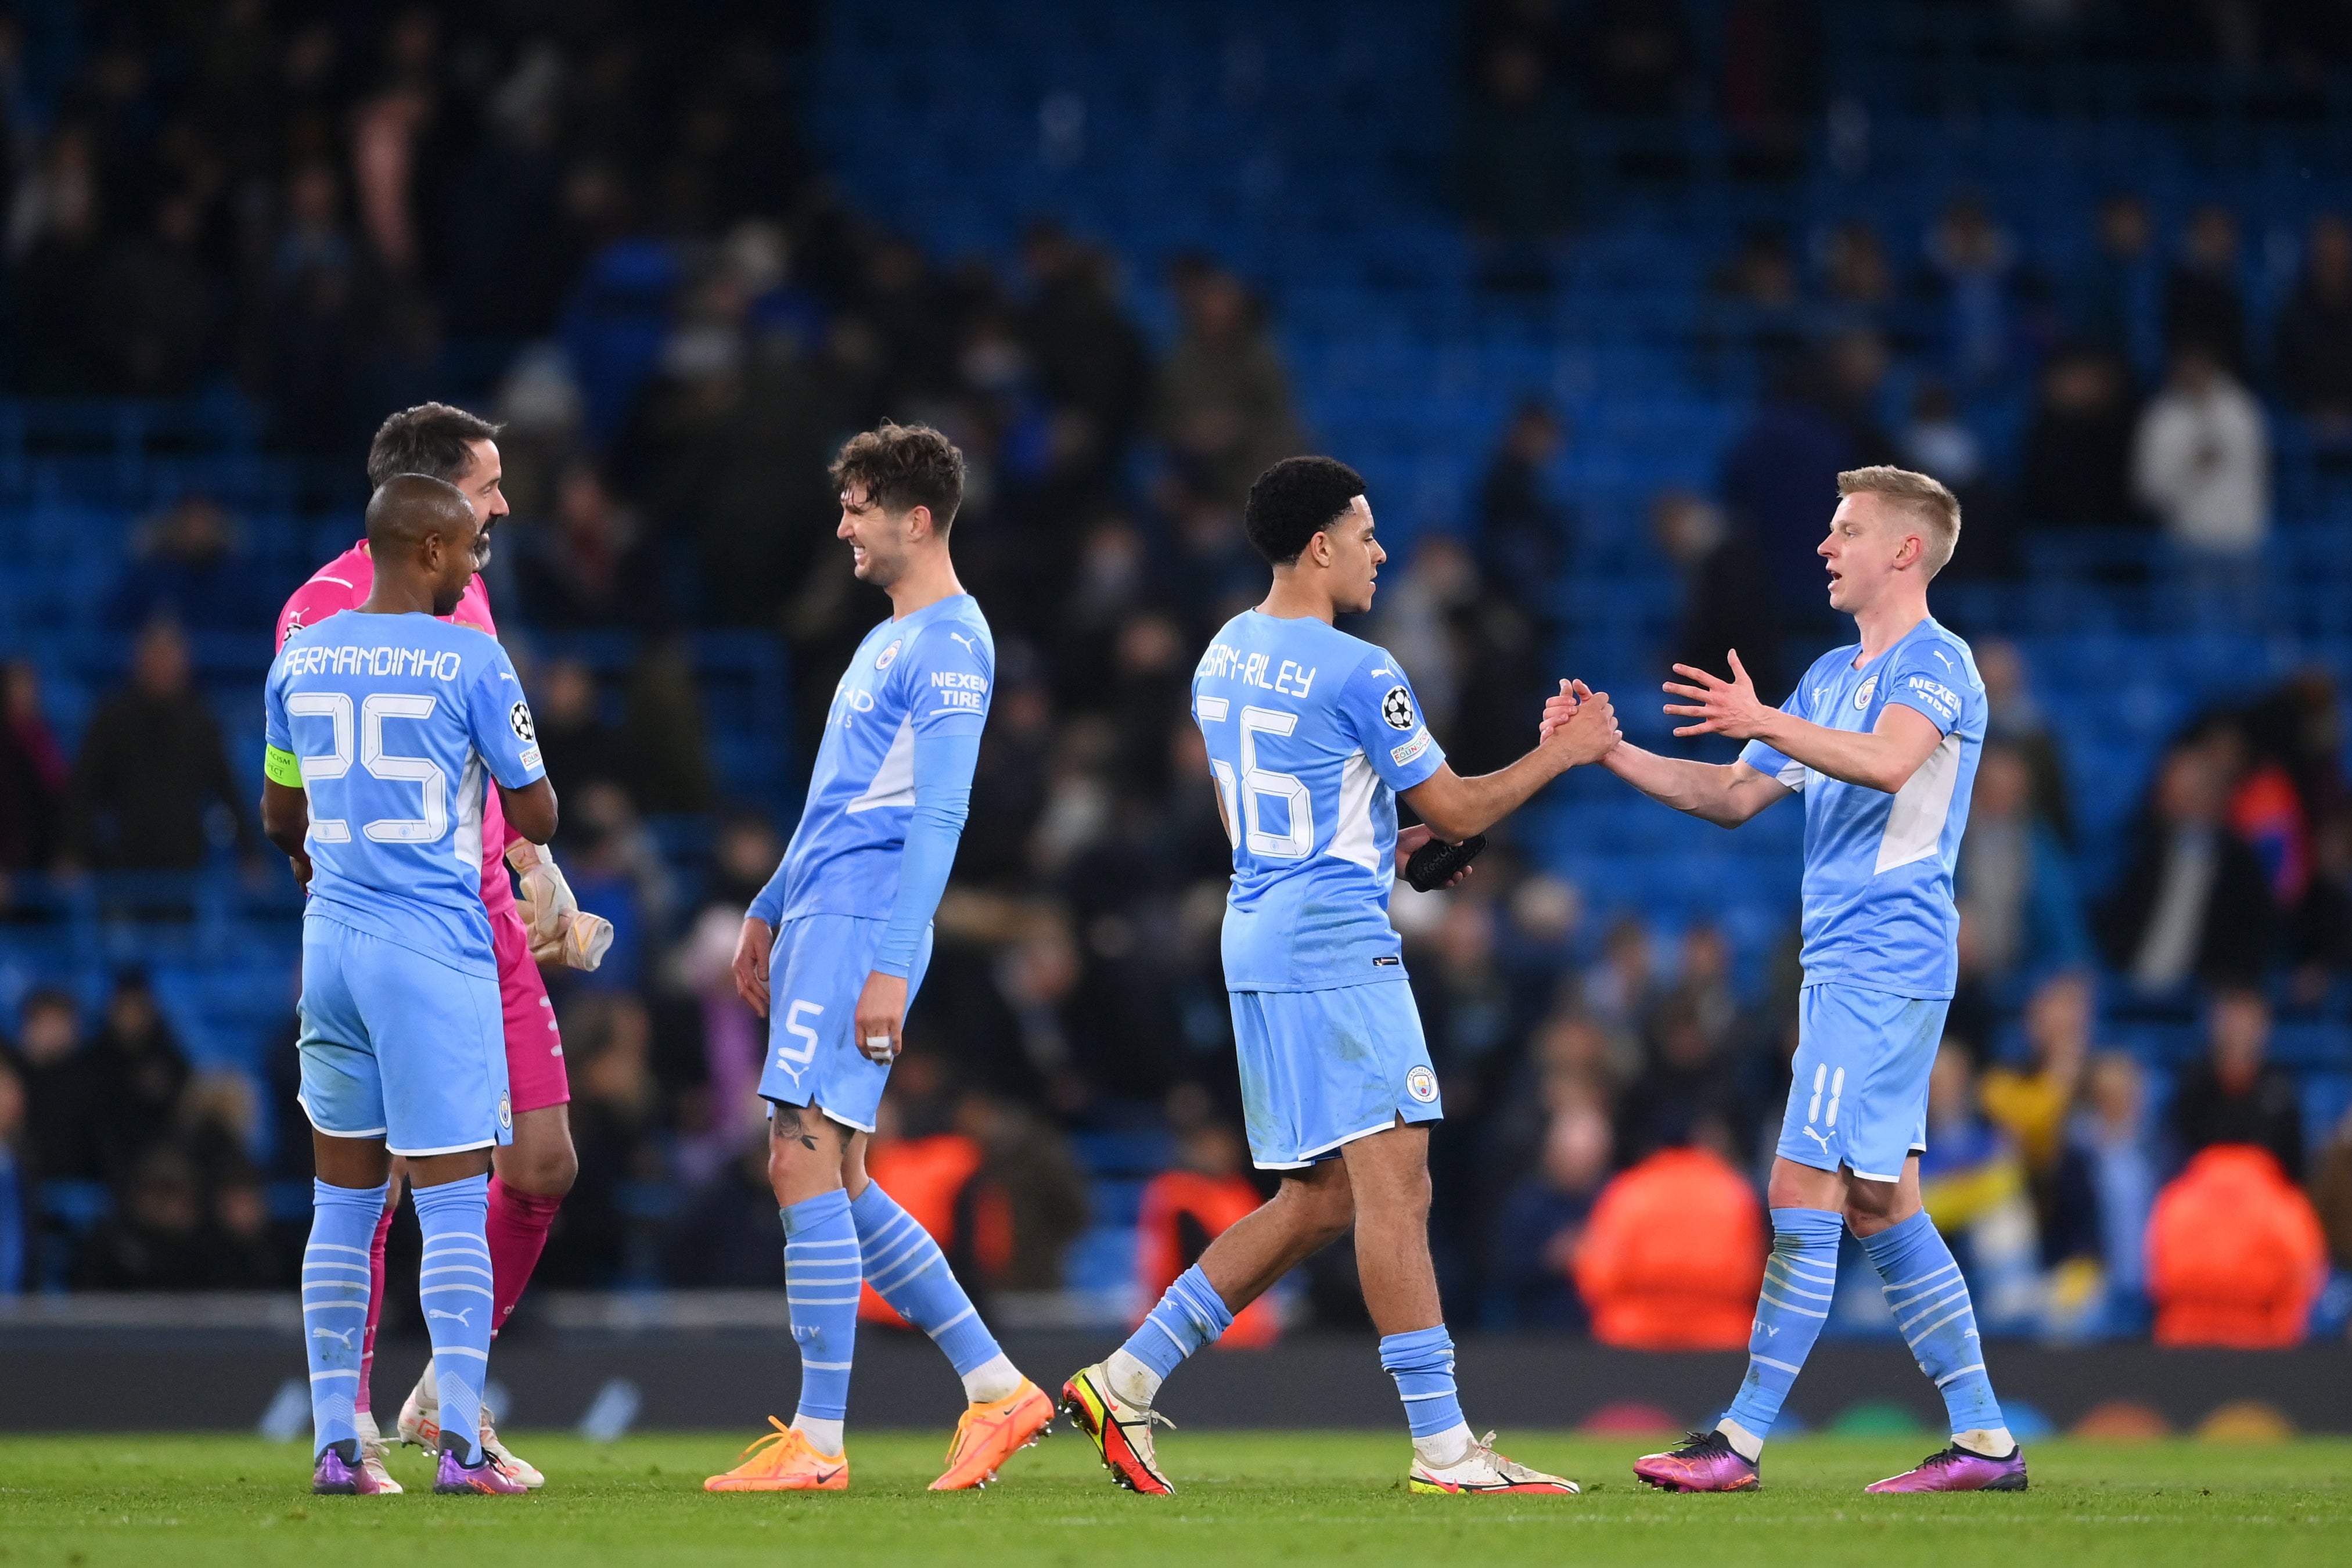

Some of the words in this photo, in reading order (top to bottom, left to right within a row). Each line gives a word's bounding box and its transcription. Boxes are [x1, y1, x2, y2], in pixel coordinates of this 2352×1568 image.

[282, 646, 461, 682] FERNANDINHO
[931, 672, 988, 693] NEXEN
[940, 690, 981, 708] TIRE
[1908, 677, 1962, 715] NEXEN
[288, 691, 448, 844] 25
[778, 999, 825, 1064] 5
[1808, 1063, 1845, 1127] 11
